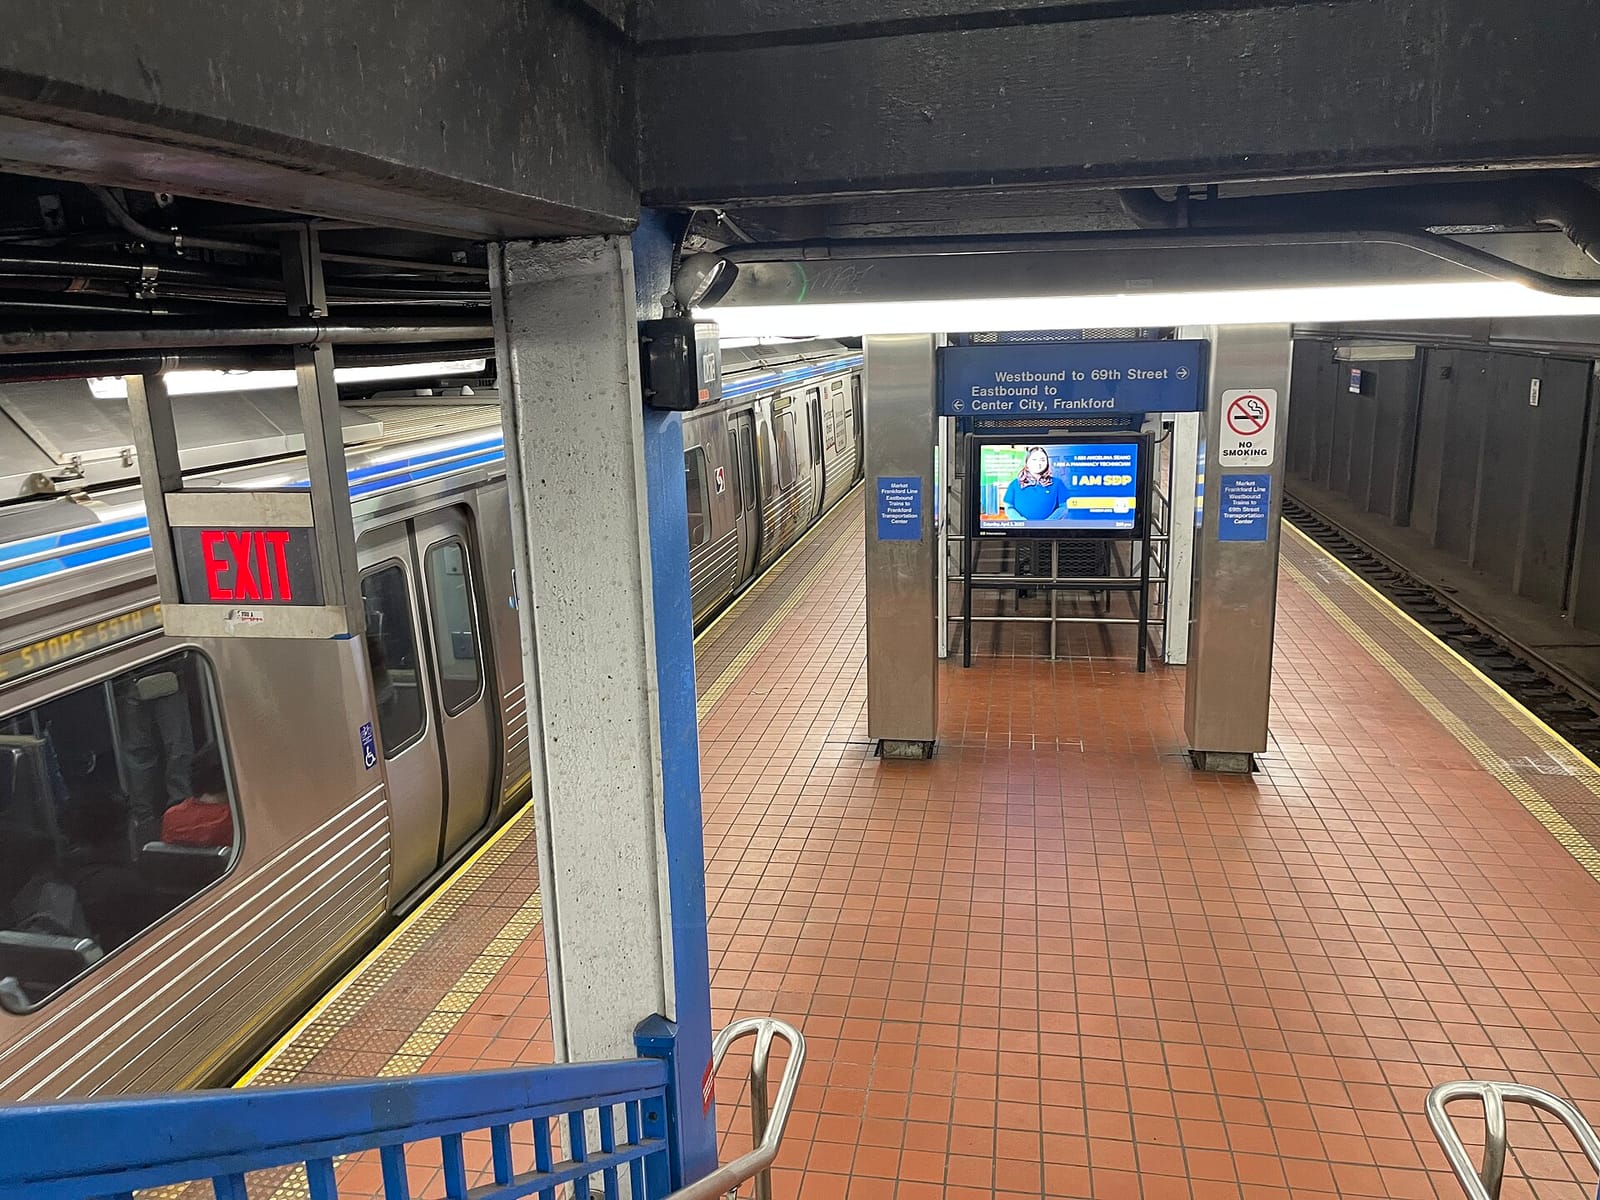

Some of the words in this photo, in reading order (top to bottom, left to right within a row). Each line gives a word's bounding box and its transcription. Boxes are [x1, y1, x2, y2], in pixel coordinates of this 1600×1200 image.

[995, 371, 1065, 382] Westbound
[1071, 371, 1085, 381] to
[1091, 369, 1121, 380] 69th
[1127, 368, 1168, 380] Street
[971, 385, 1038, 397] Eastbound
[1044, 386, 1057, 396] to
[971, 400, 1013, 411] Center
[1019, 399, 1048, 411] City,
[1053, 398, 1115, 409] Frankford
[1072, 475, 1078, 485] I
[1079, 475, 1102, 485] AM
[200, 530, 291, 601] EXIT
